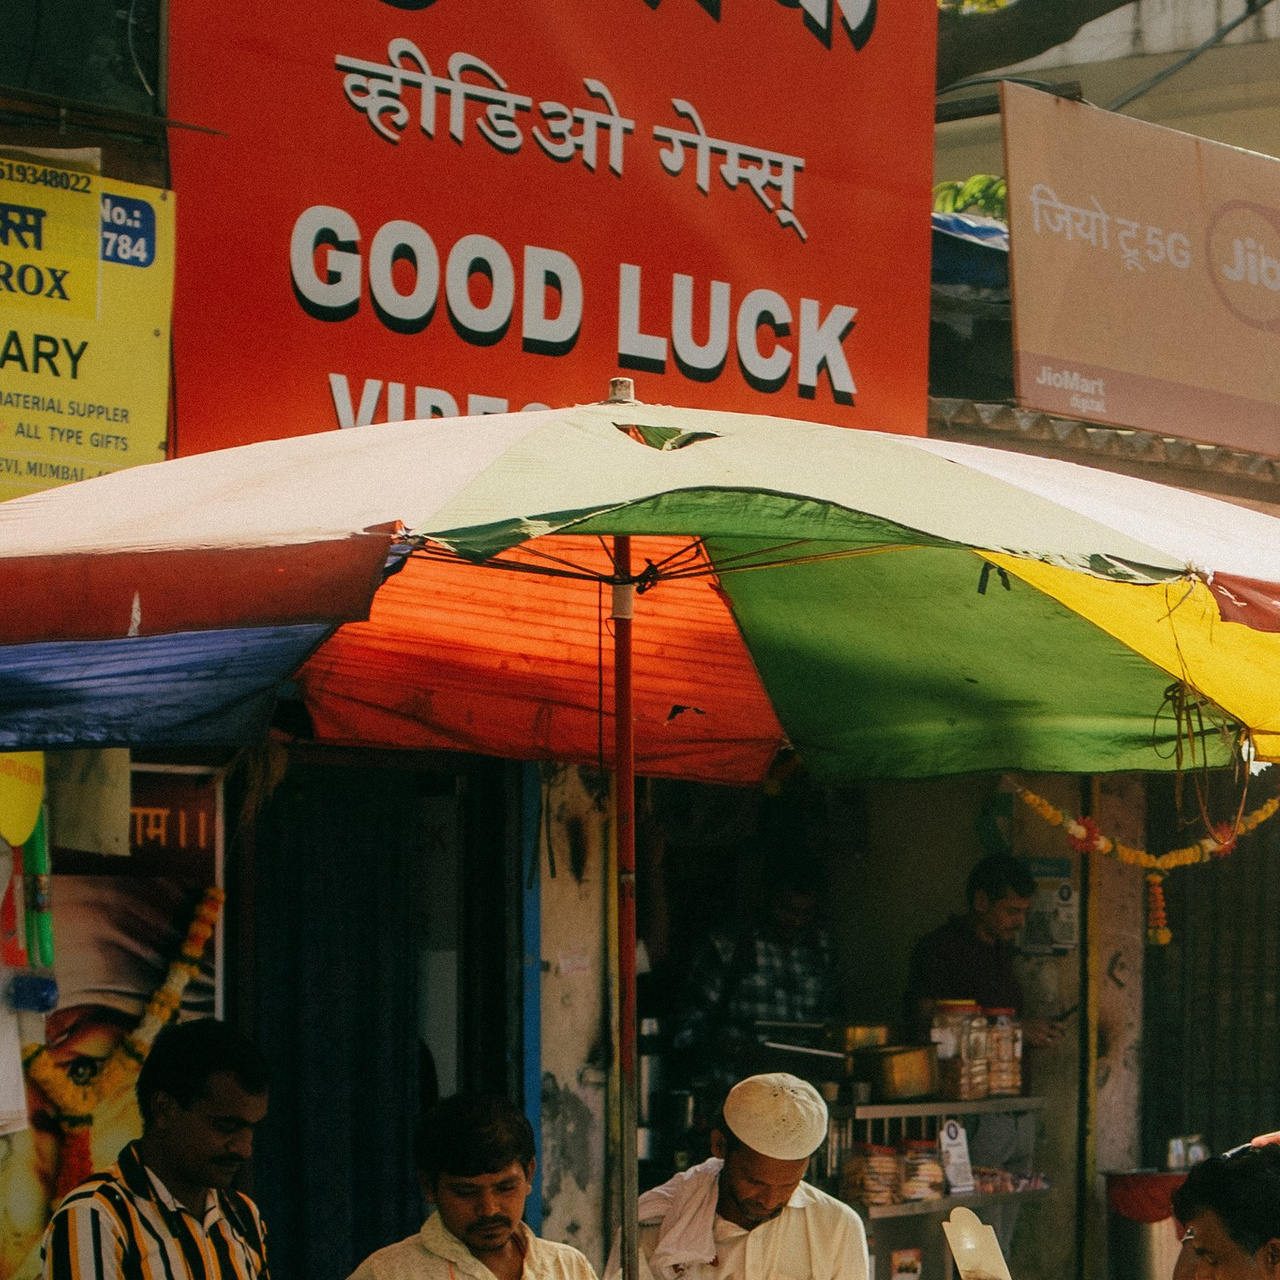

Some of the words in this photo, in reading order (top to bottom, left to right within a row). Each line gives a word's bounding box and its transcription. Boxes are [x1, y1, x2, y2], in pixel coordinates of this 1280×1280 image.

[334, 37, 636, 177] व्हीडिओ
[1030, 183, 1109, 250] जियो
[1146, 226, 1192, 270] 5G
[290, 205, 584, 356] GOOD
[617, 263, 858, 406] LUCK
[0, 330, 89, 380] ARY
[1035, 365, 1106, 397] JioMart
[15, 422, 42, 440] ALL
[48, 425, 84, 446] TYPE
[89, 431, 129, 451] GIFTS
[67, 400, 130, 424] SUPPLER
